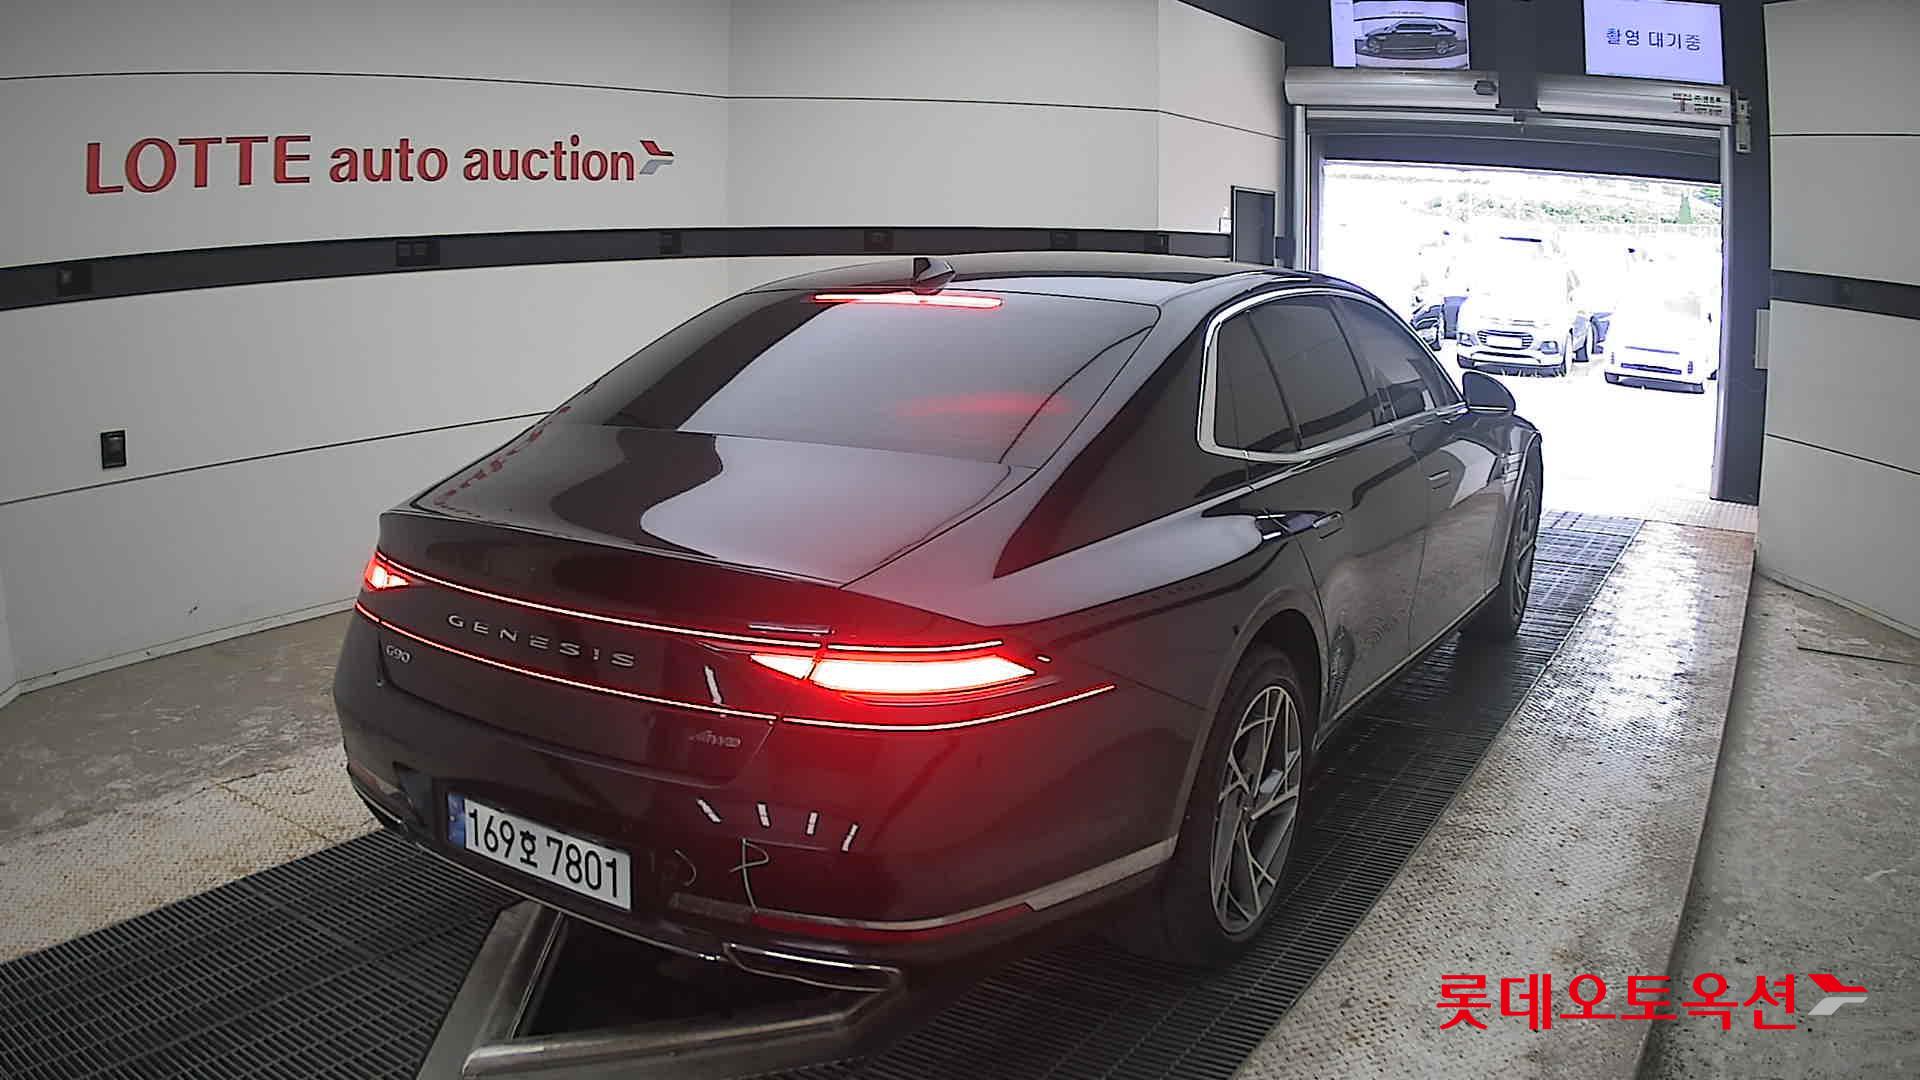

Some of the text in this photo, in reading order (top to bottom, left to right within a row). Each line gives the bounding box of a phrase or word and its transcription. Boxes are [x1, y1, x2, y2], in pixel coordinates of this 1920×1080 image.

[1607, 27, 1701, 51] 촬영 대기중
[86, 134, 635, 194] LOTTE auto auction
[386, 645, 410, 663] G90
[448, 614, 635, 668] GENESIS
[468, 808, 618, 898] 169호 7801
